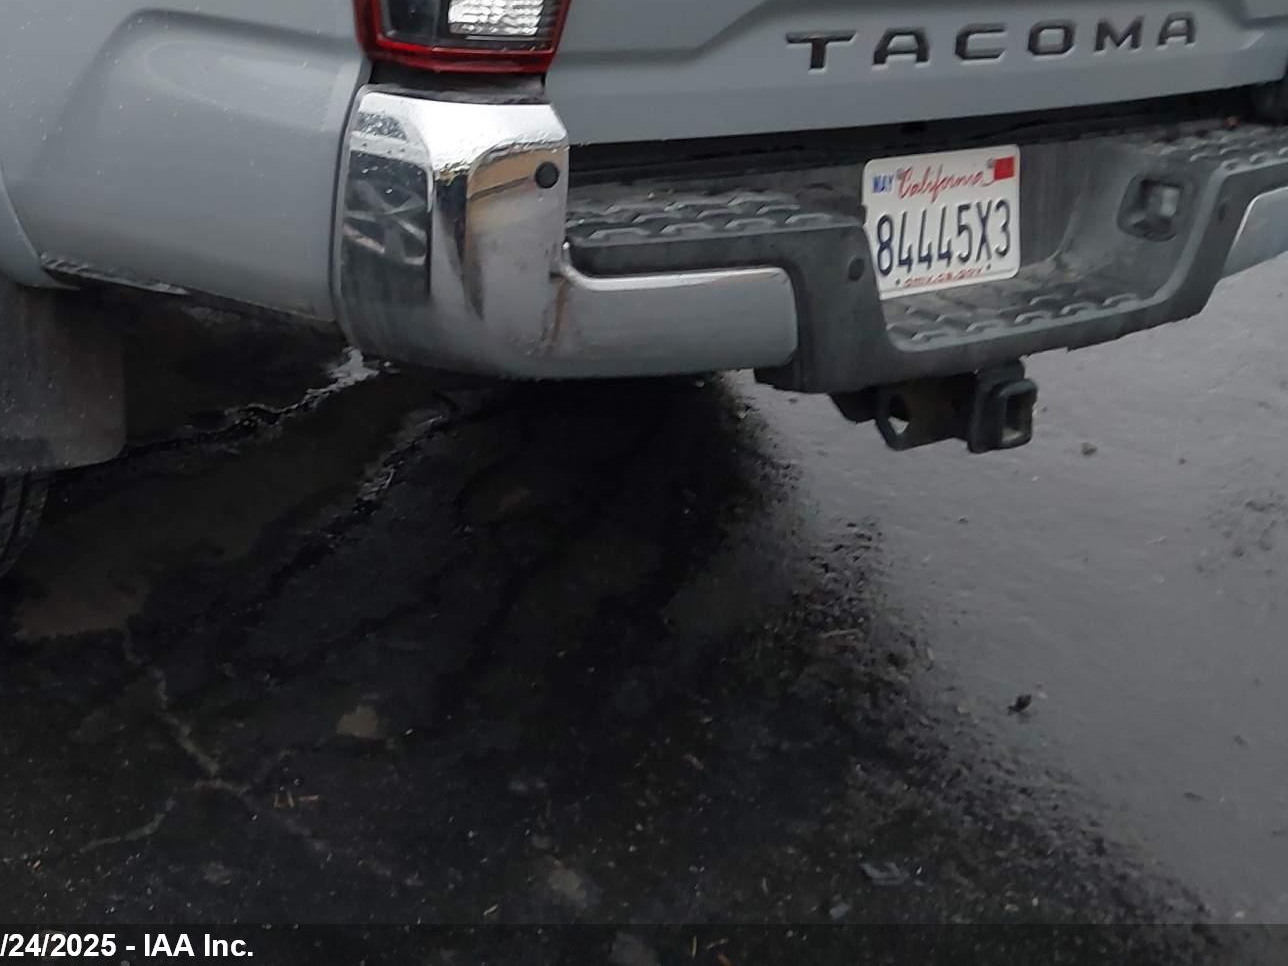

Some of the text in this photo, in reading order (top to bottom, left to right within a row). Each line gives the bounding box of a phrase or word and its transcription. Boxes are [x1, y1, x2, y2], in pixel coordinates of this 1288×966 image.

[785, 11, 1199, 71] TACOMA
[898, 164, 995, 203] California
[877, 199, 1011, 276] 84445X3
